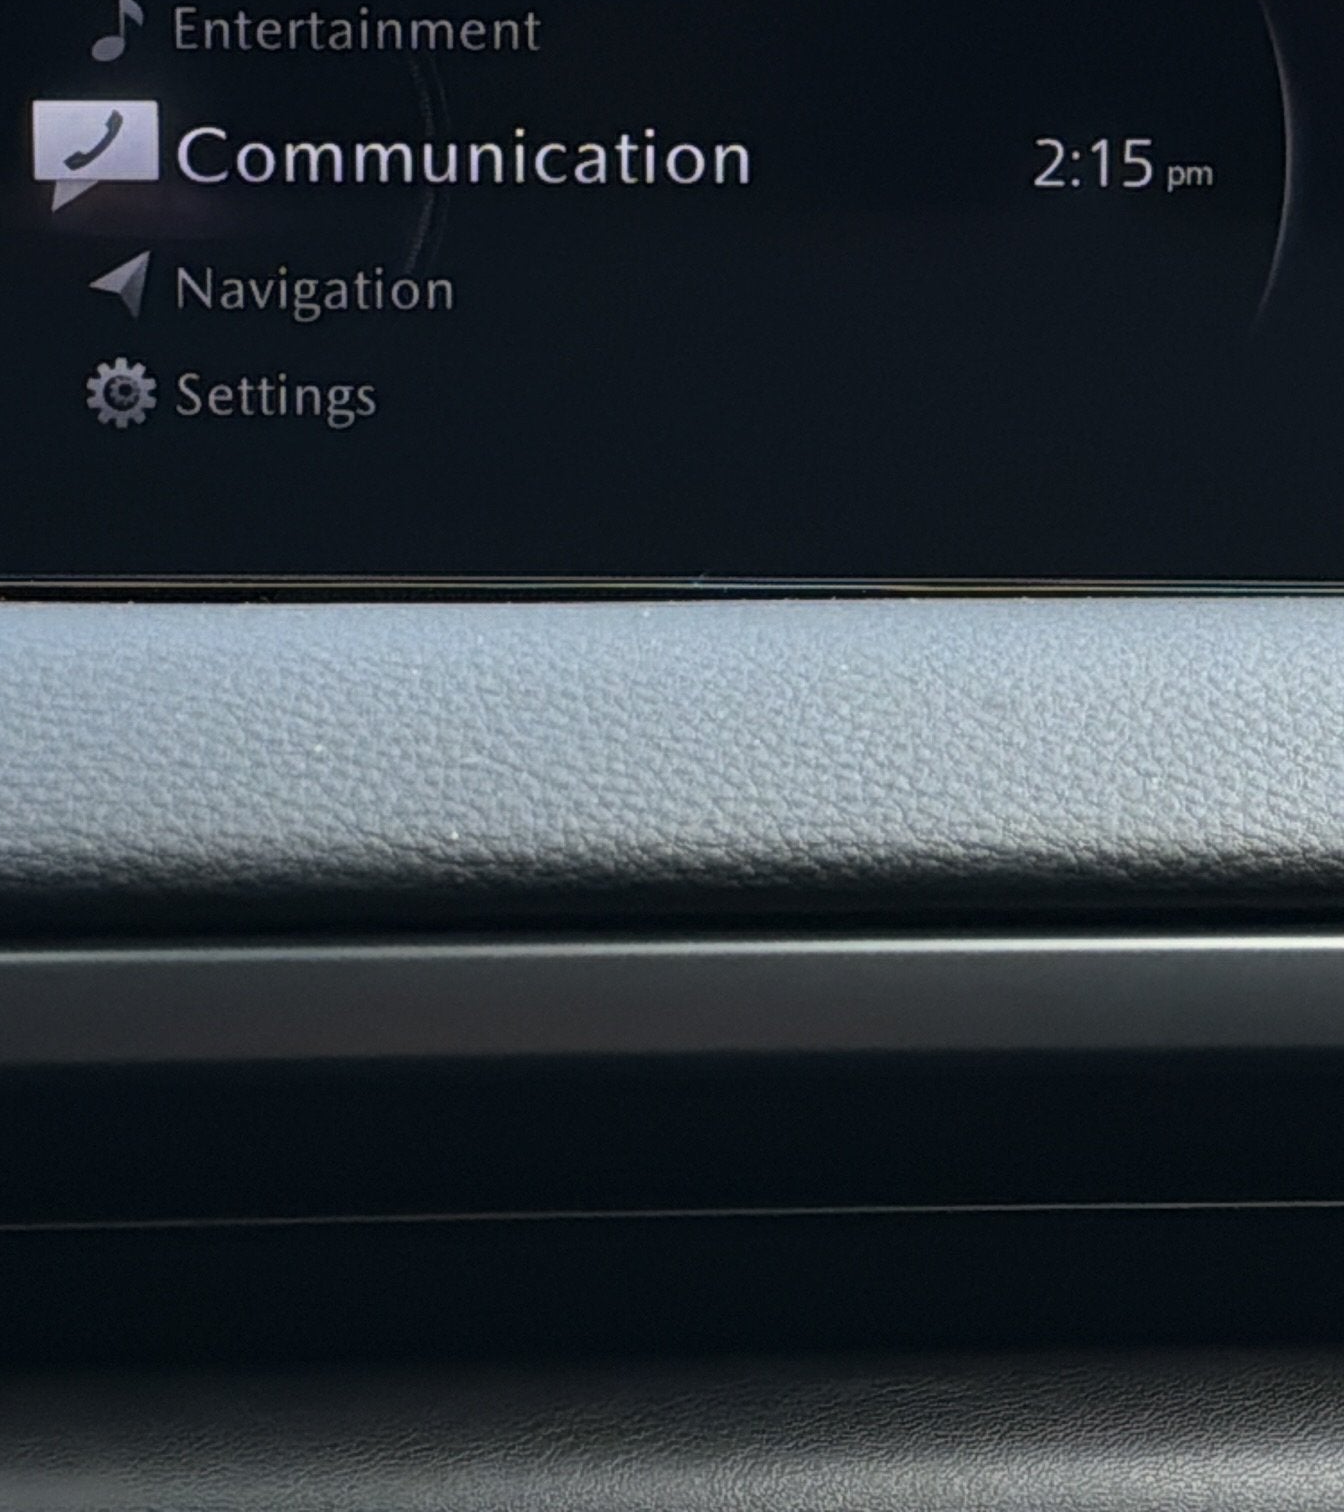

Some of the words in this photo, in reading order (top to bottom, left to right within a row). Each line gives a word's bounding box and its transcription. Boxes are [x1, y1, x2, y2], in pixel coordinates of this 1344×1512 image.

[174, 6, 542, 52] Entertainment
[177, 126, 750, 185] Communication
[1033, 137, 1154, 189] 2:15
[1166, 164, 1214, 194] pm
[177, 266, 454, 323] Navigation
[176, 372, 376, 430] Settings
